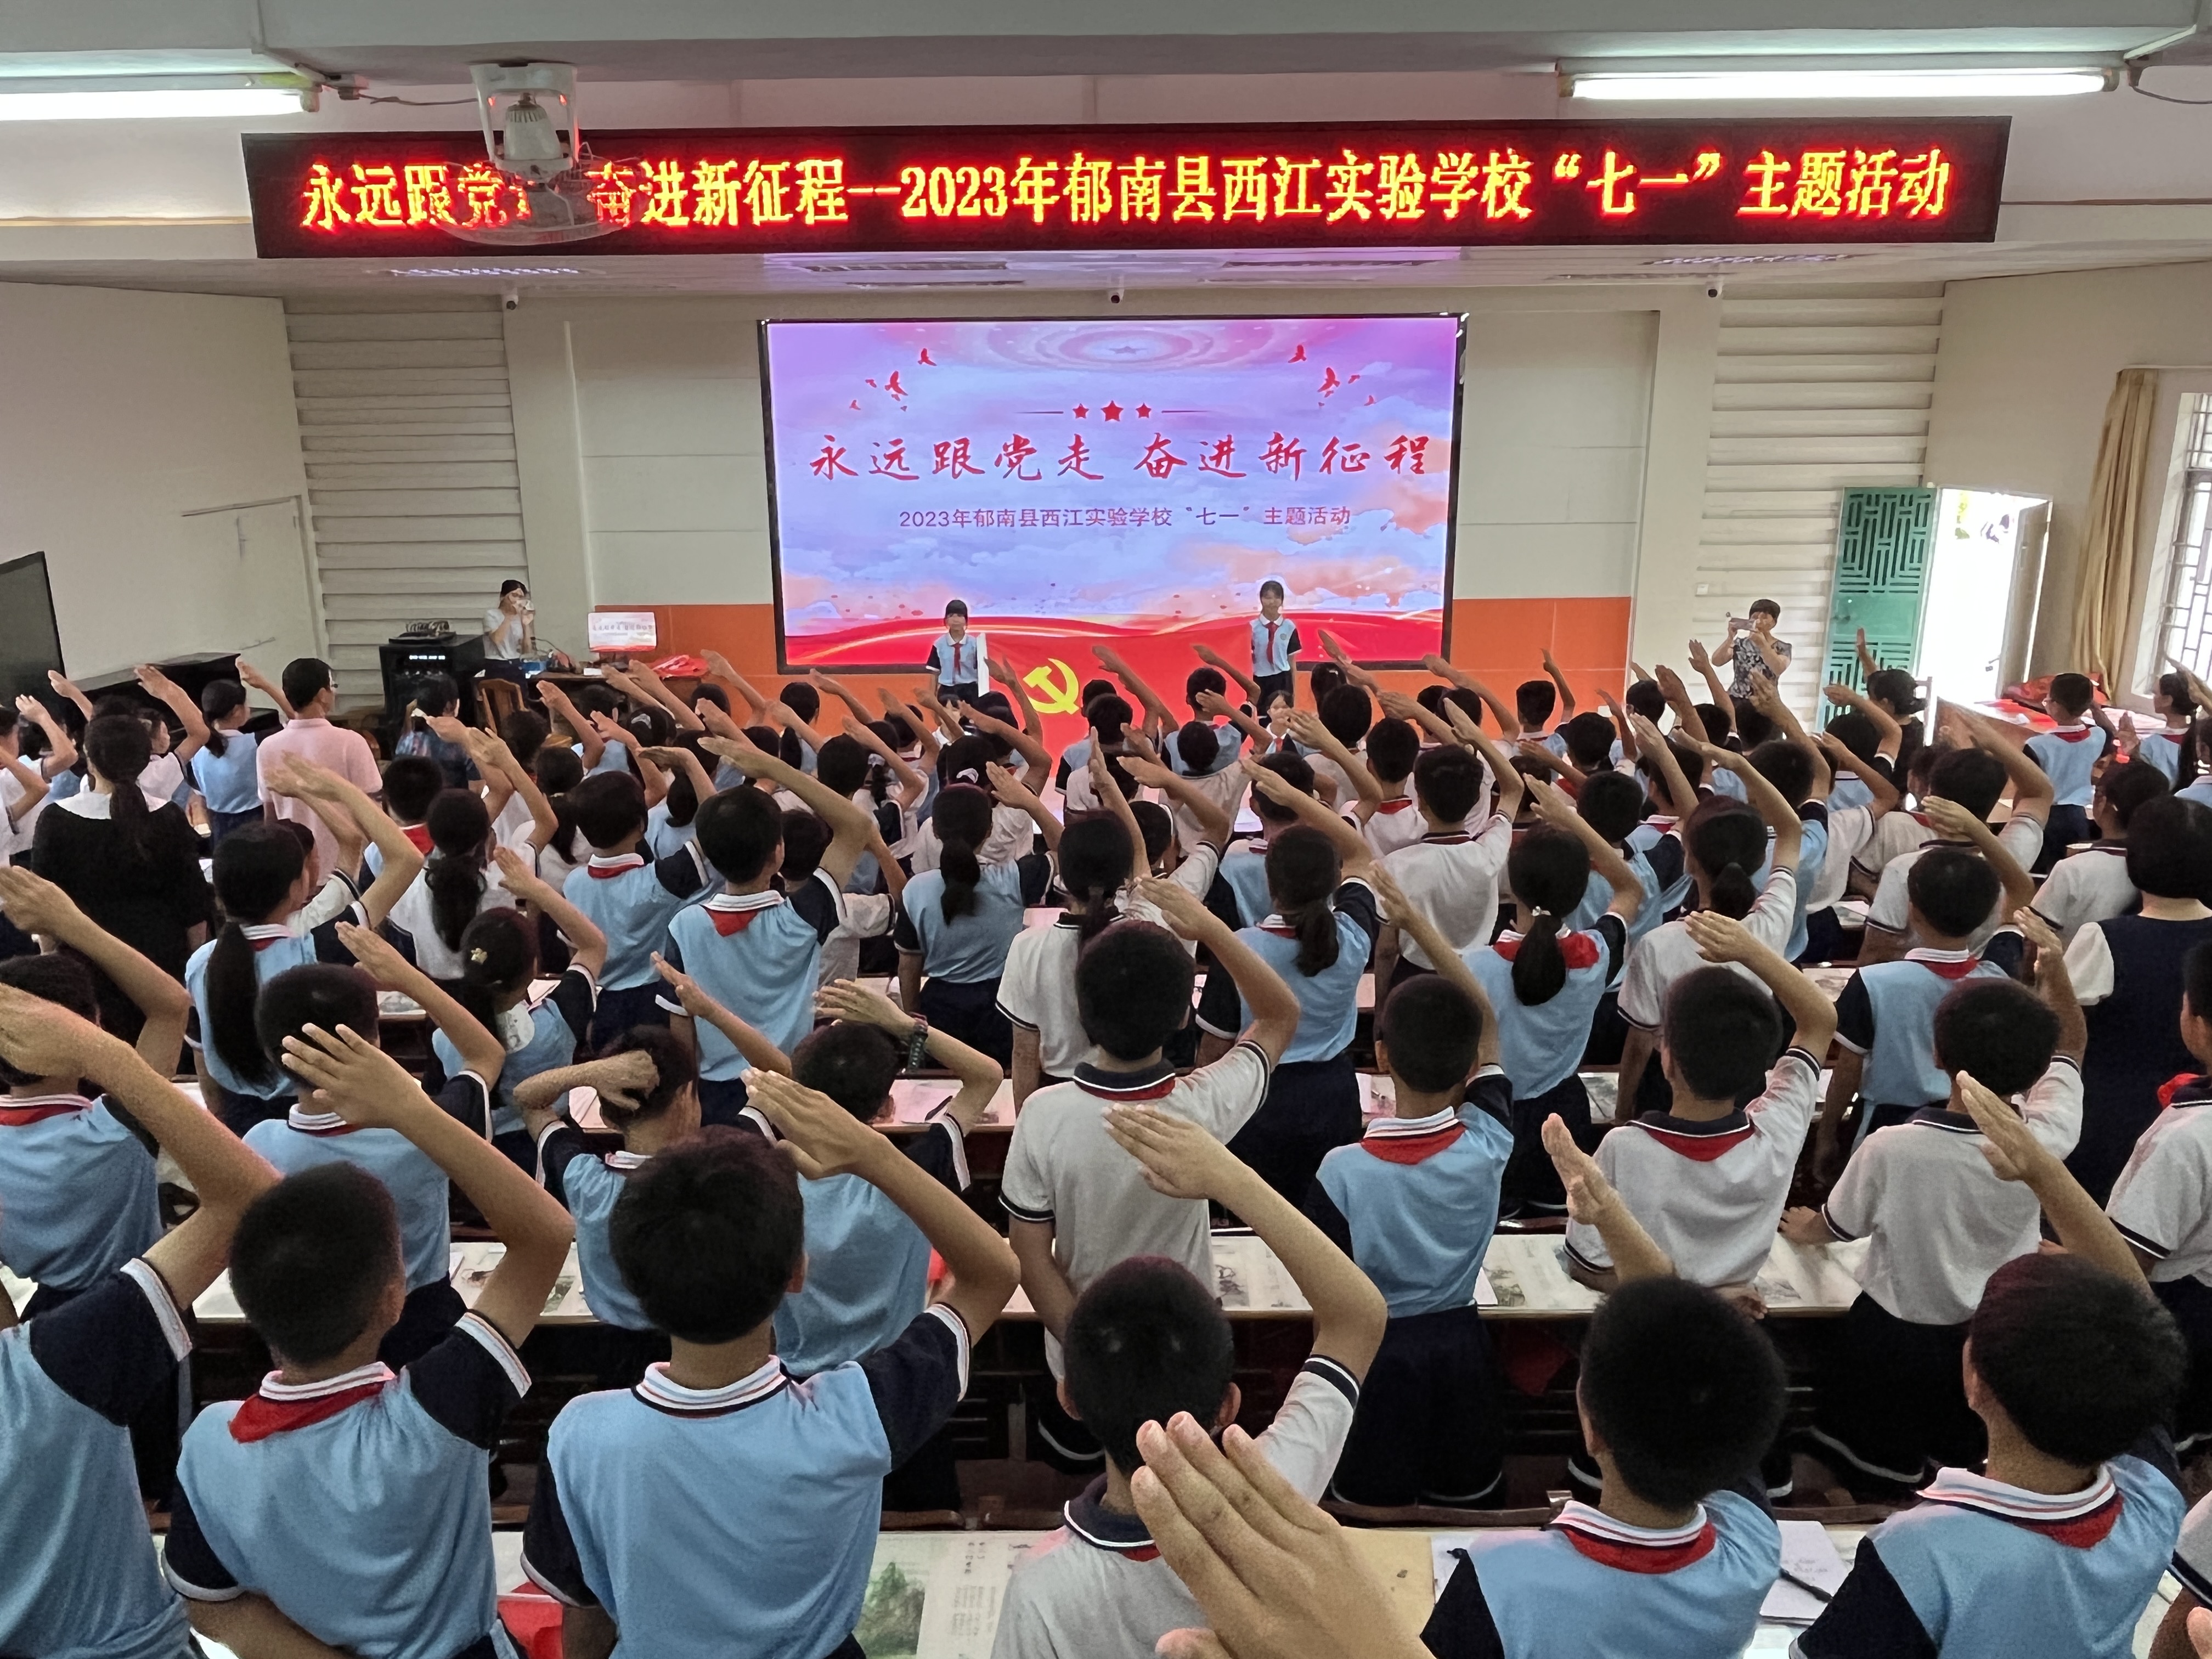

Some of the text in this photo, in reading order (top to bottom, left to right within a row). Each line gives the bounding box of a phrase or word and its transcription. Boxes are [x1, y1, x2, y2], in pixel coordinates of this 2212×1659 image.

[301, 162, 535, 228] 永远跟党
[810, 432, 1430, 481] 永远跟党走 奋进新征程
